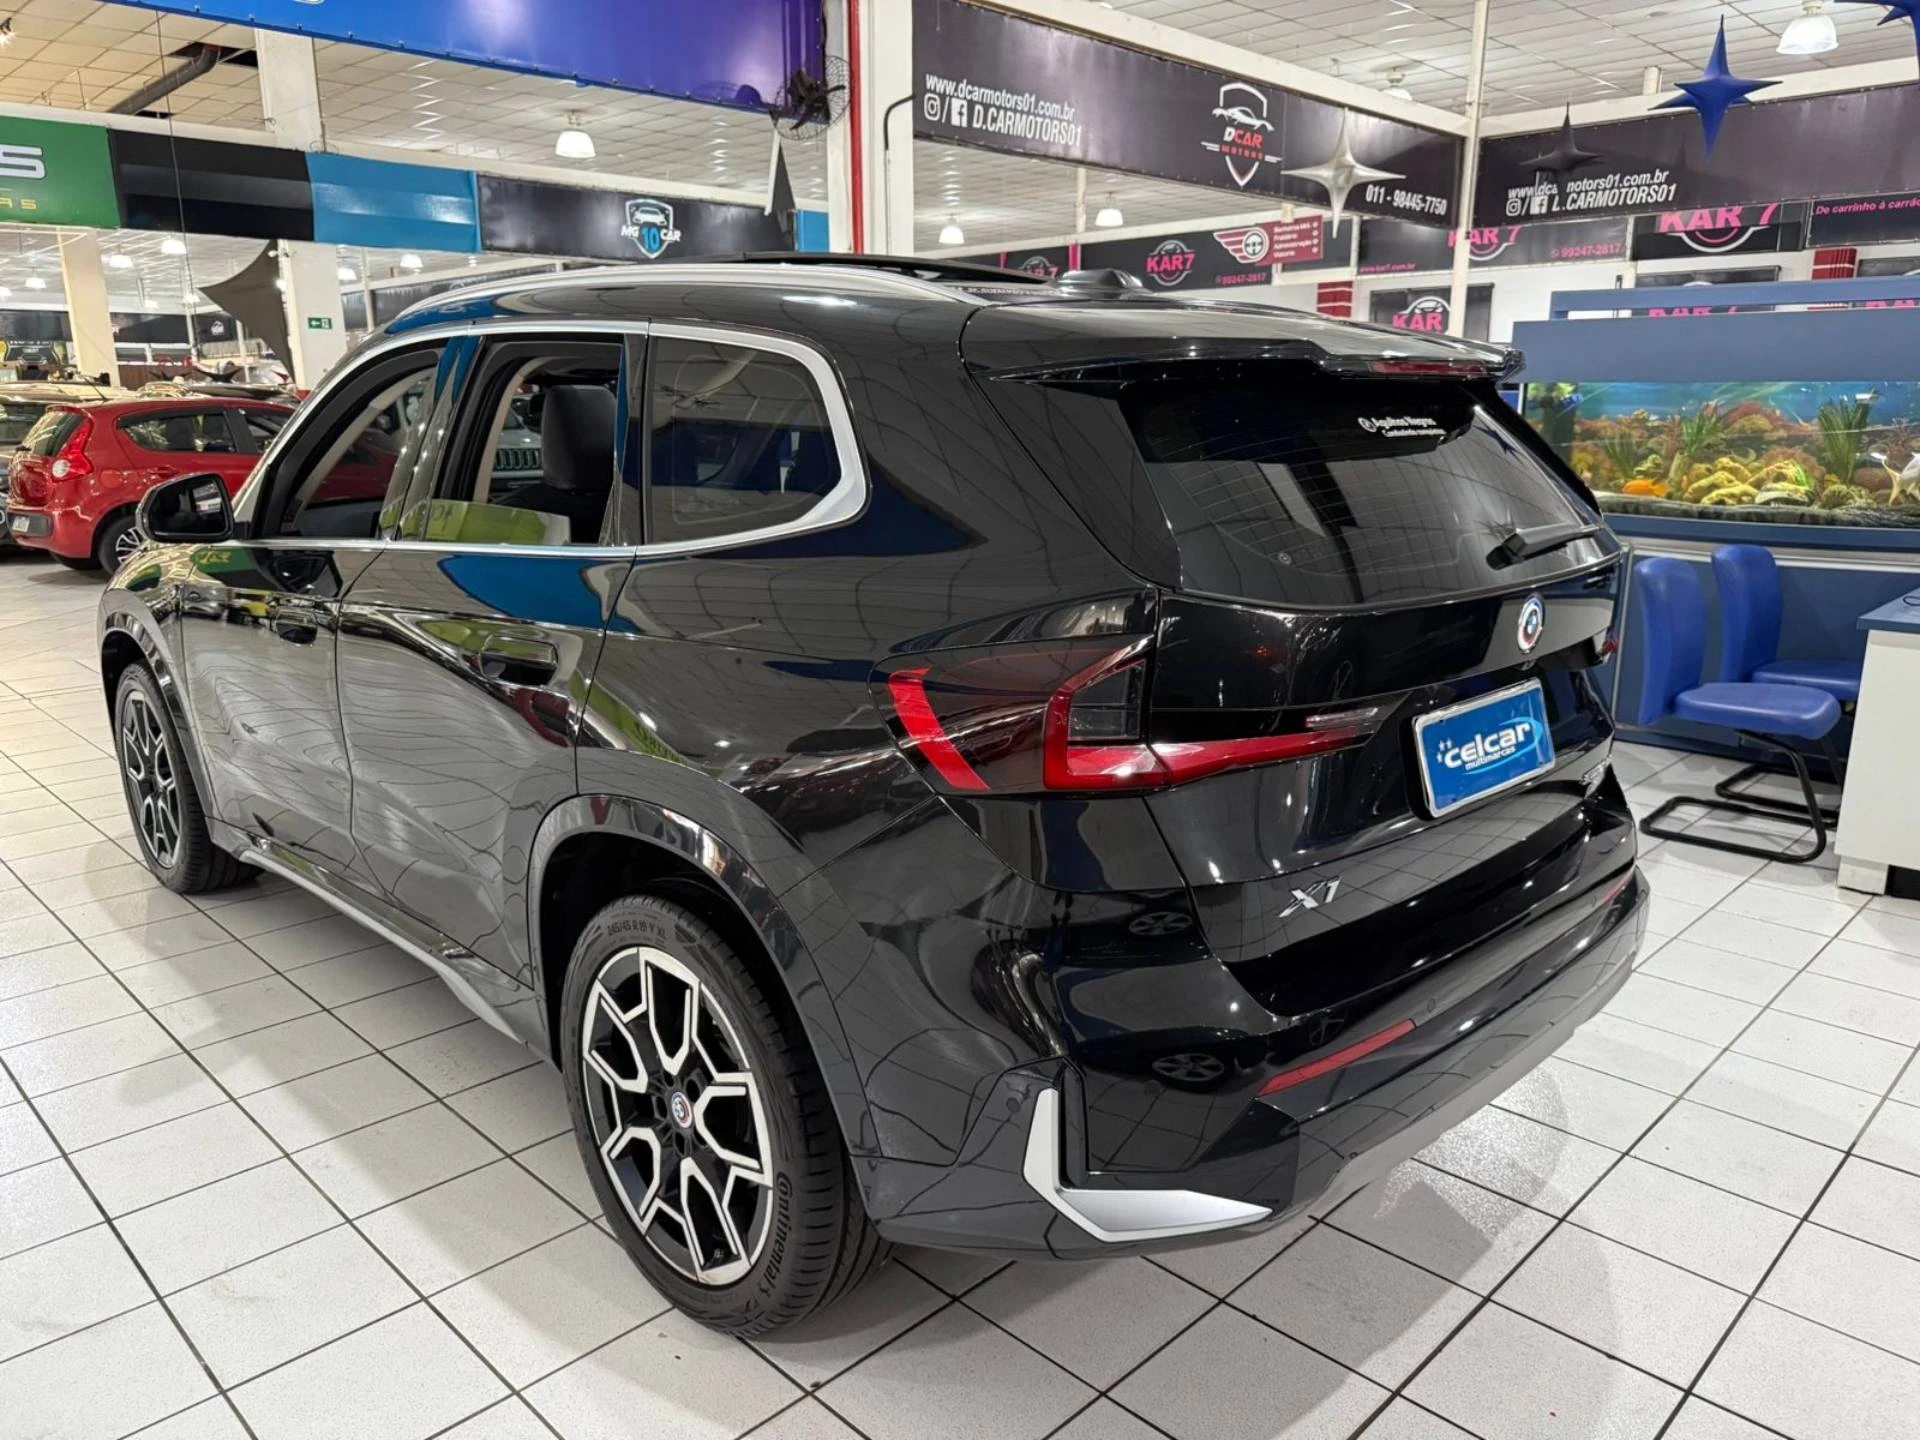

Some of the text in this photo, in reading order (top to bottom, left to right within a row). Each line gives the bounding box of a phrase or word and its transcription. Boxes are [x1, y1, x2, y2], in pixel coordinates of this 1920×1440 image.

[925, 73, 1076, 121] www.dcarmotors01.com.br
[972, 104, 1082, 147] D.CARMOTORS01
[1223, 127, 1263, 149] DCAR
[1507, 168, 1669, 198] www.dcamotors01.com.br
[1366, 184, 1386, 204] 011
[1393, 189, 1448, 216] 98445-7750
[1816, 206, 1829, 215] De
[1832, 202, 1876, 213] carrinho
[1659, 206, 1743, 233] KAR
[620, 225, 682, 253] MG 10 CAR
[1392, 312, 1443, 334] KAR
[1444, 723, 1531, 768] celcar
[1279, 877, 1343, 918] X1
